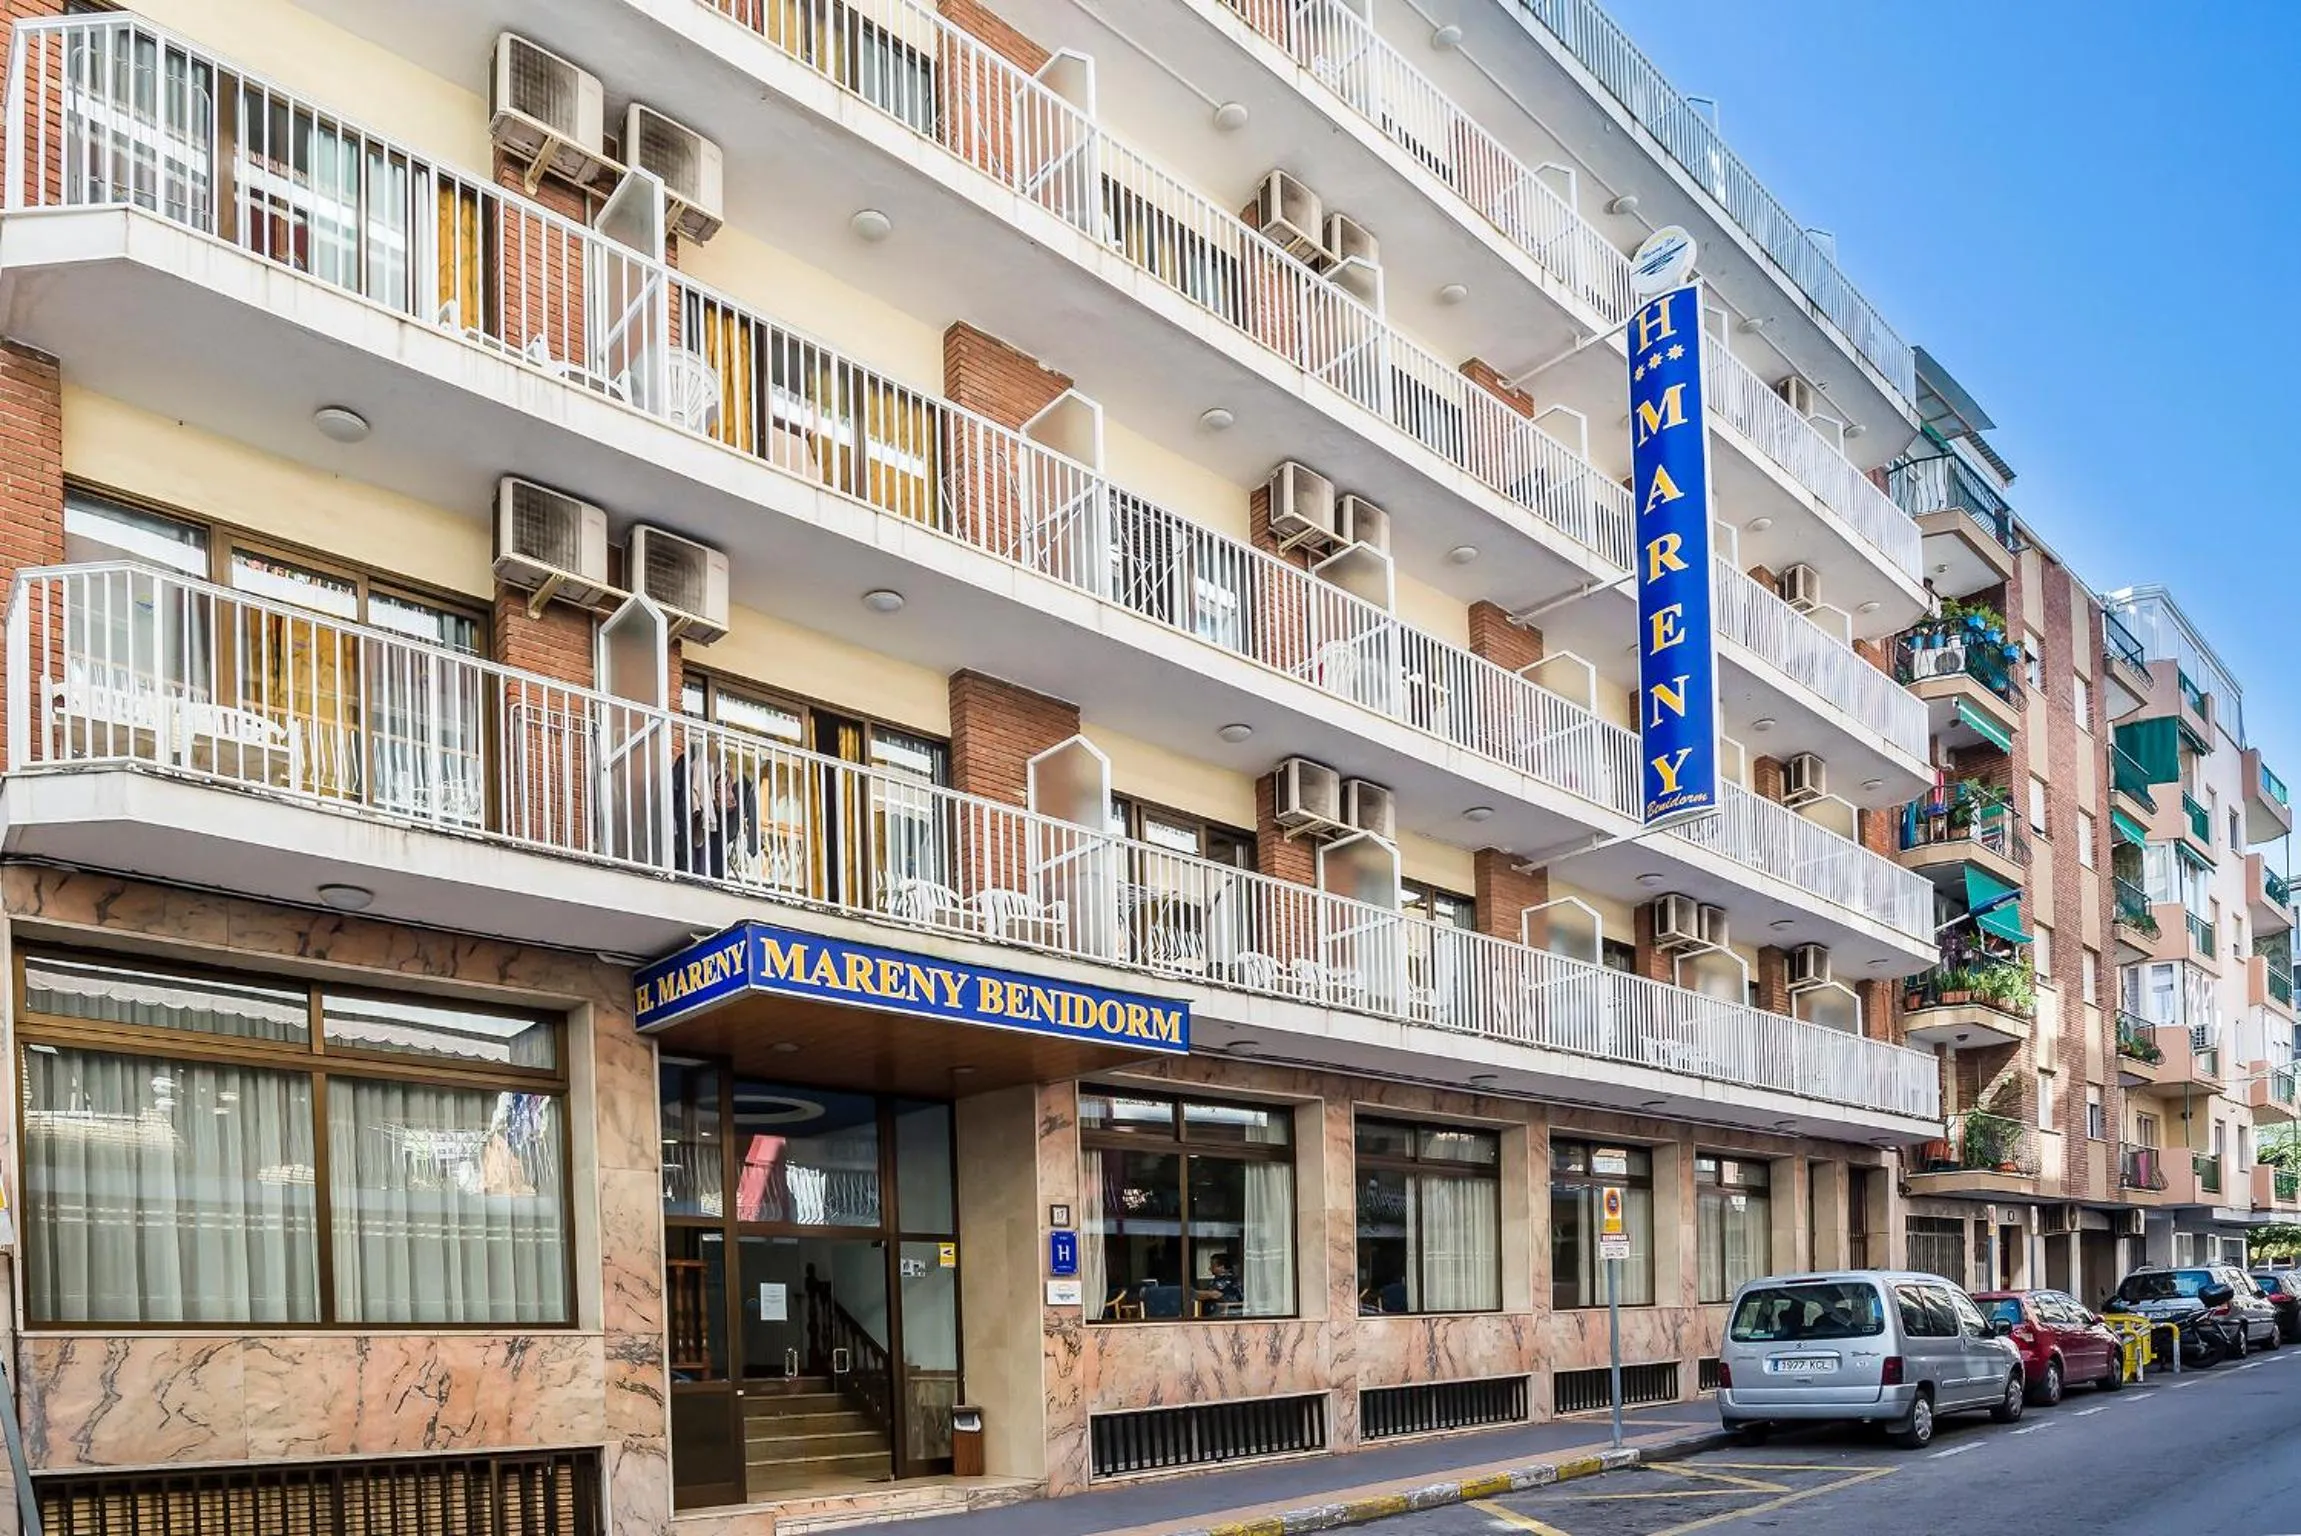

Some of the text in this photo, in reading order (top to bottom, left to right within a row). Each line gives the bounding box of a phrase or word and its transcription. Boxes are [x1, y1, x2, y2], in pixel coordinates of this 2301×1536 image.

[1636, 294, 1677, 355] H
[1636, 382, 1692, 797] MARENY
[1646, 792, 1708, 818] Benidorm
[636, 939, 747, 1016] H. MARENY
[759, 937, 1183, 1044] MARENY BENIDORM
[1057, 1244, 1070, 1262] H
